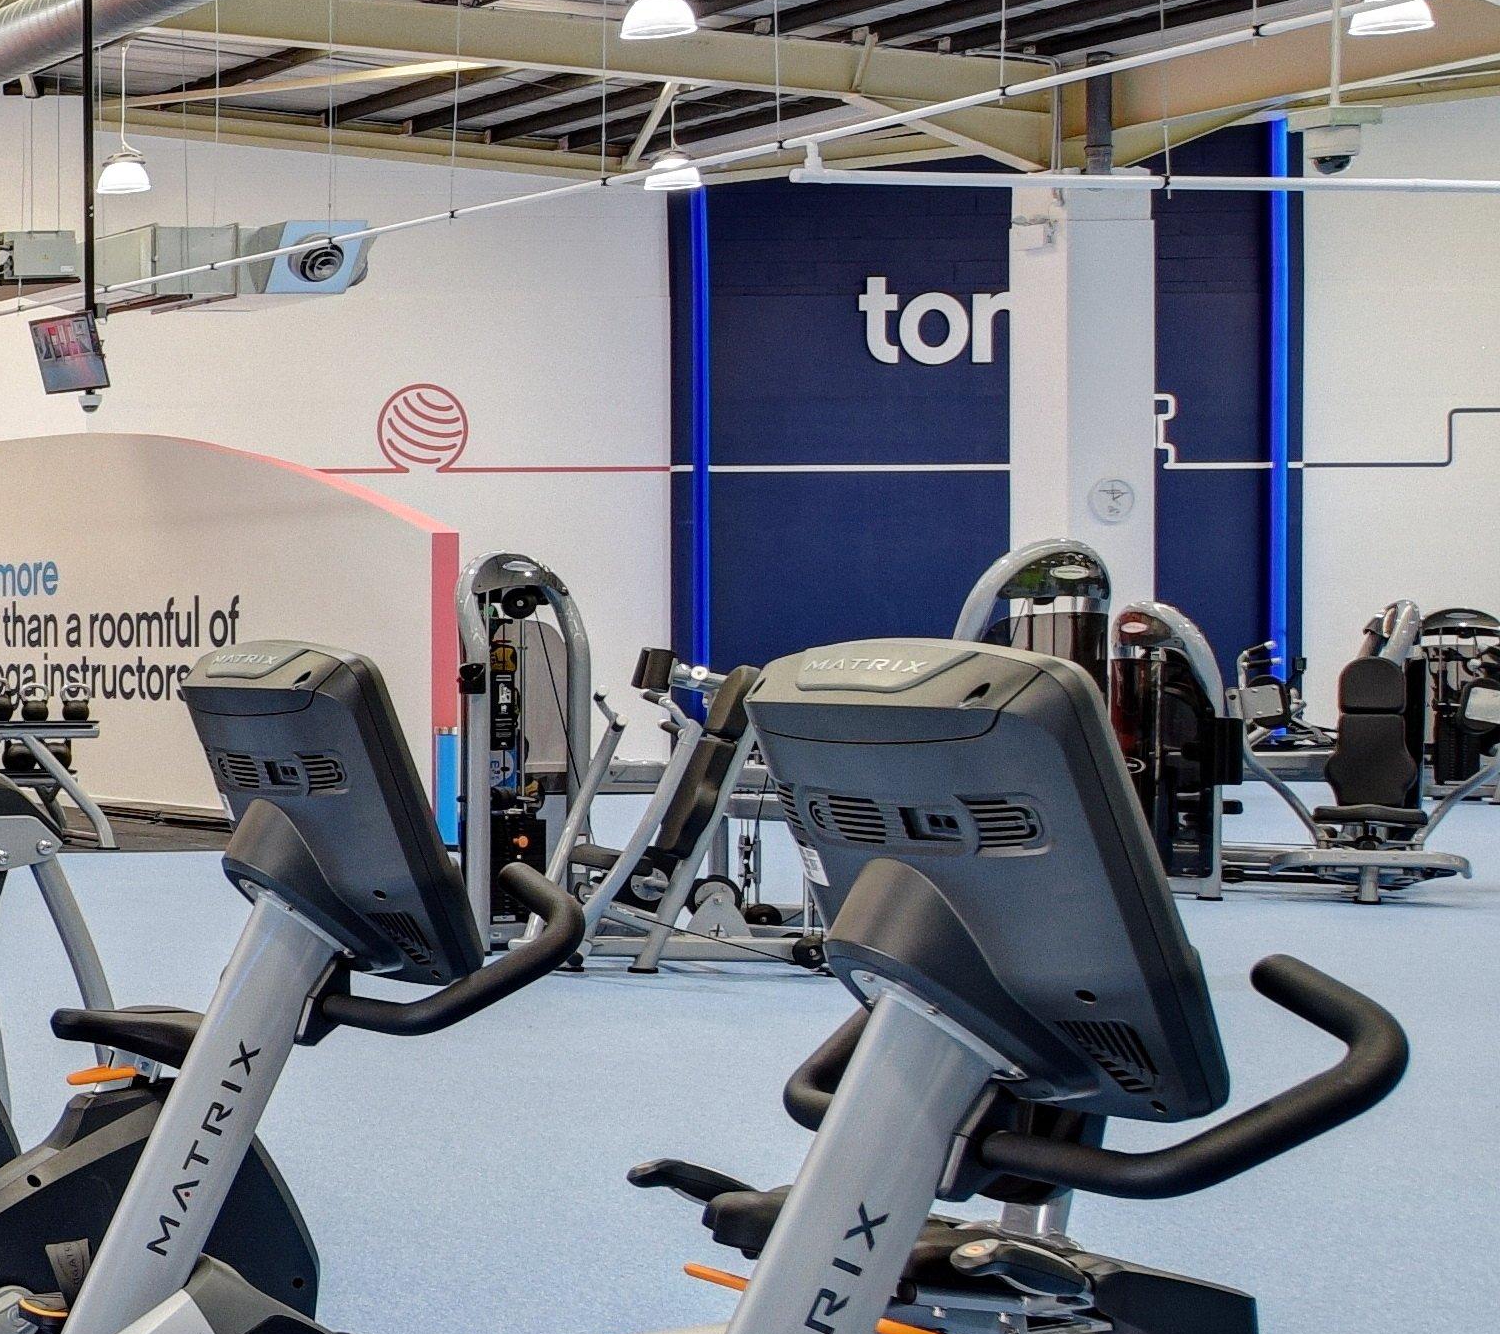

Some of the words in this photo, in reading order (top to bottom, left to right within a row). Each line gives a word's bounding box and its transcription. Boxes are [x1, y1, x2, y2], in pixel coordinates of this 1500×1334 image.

[2, 601, 58, 649] than
[66, 612, 81, 648] a
[89, 595, 200, 649] roomful
[209, 595, 240, 648] of
[212, 653, 278, 665] MATRIX
[804, 656, 929, 675] MATRIX
[147, 1040, 262, 1257] MATRIX
